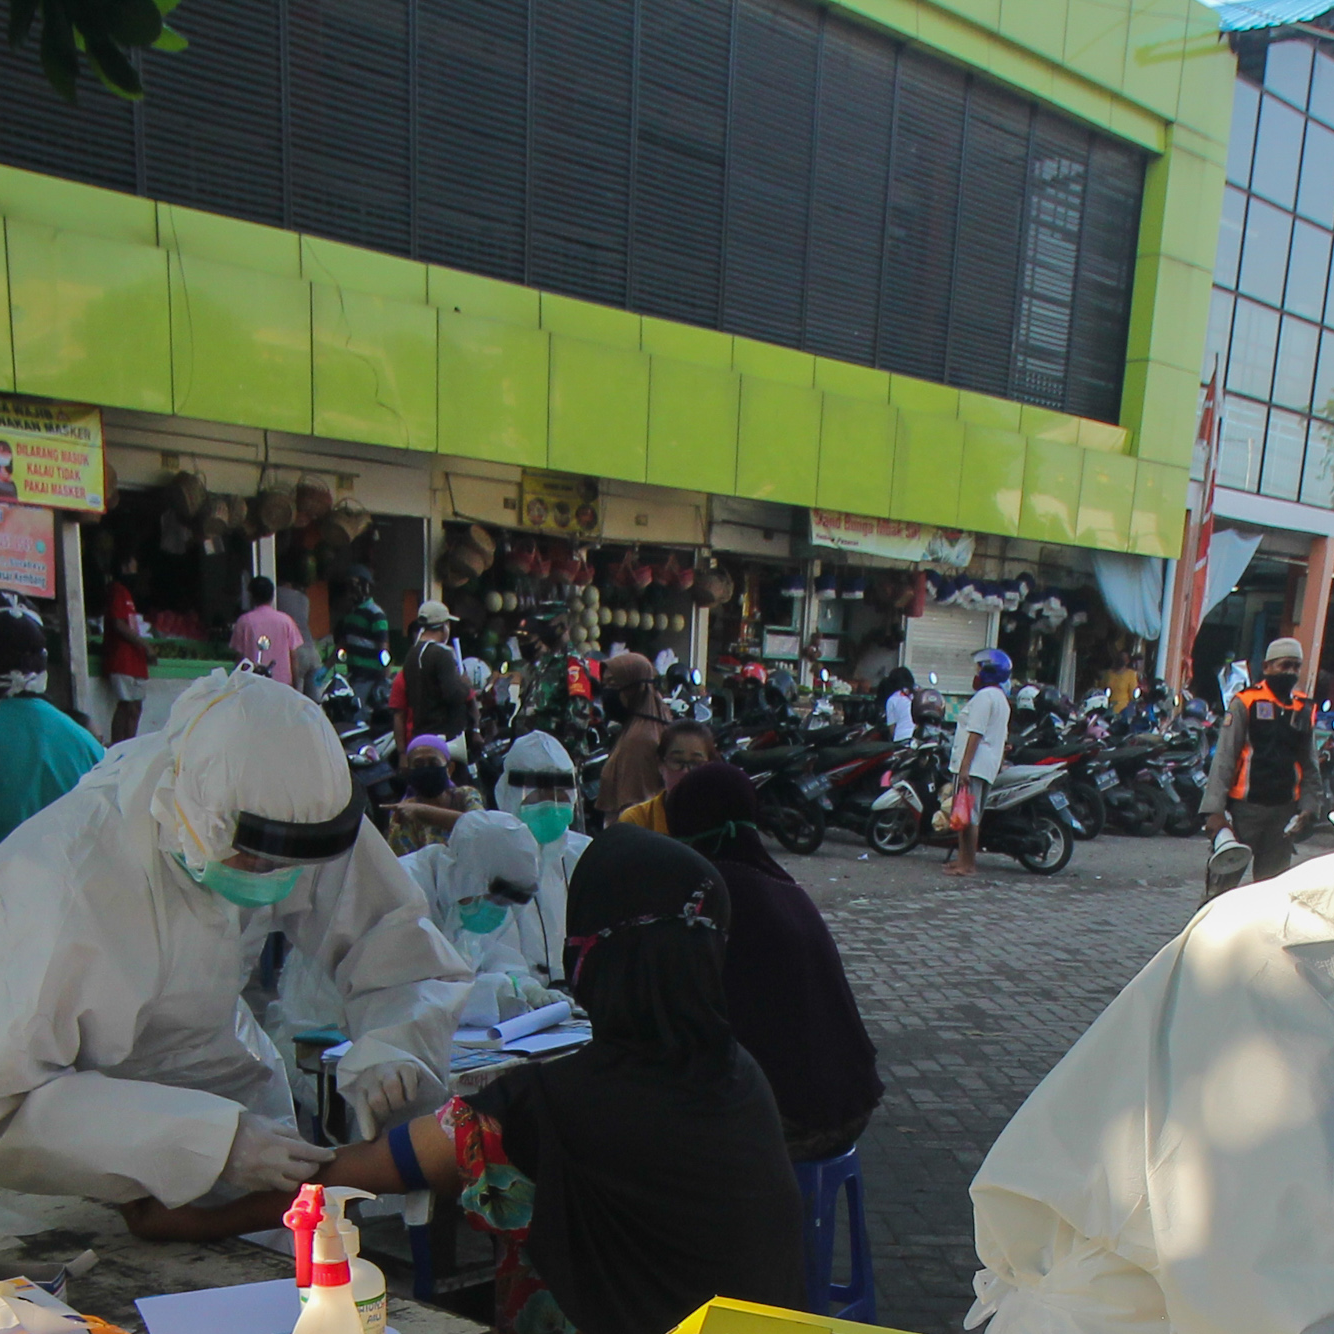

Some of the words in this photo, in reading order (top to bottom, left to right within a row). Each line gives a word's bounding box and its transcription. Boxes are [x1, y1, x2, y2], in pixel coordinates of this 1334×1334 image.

[44, 422, 91, 441] MASKER
[16, 443, 59, 462] DILARANG
[61, 451, 89, 467] MASUK
[27, 463, 55, 478] KALAU
[57, 467, 81, 481] TIDAK
[24, 479, 49, 494] PAKAI
[51, 484, 86, 499] MASKER
